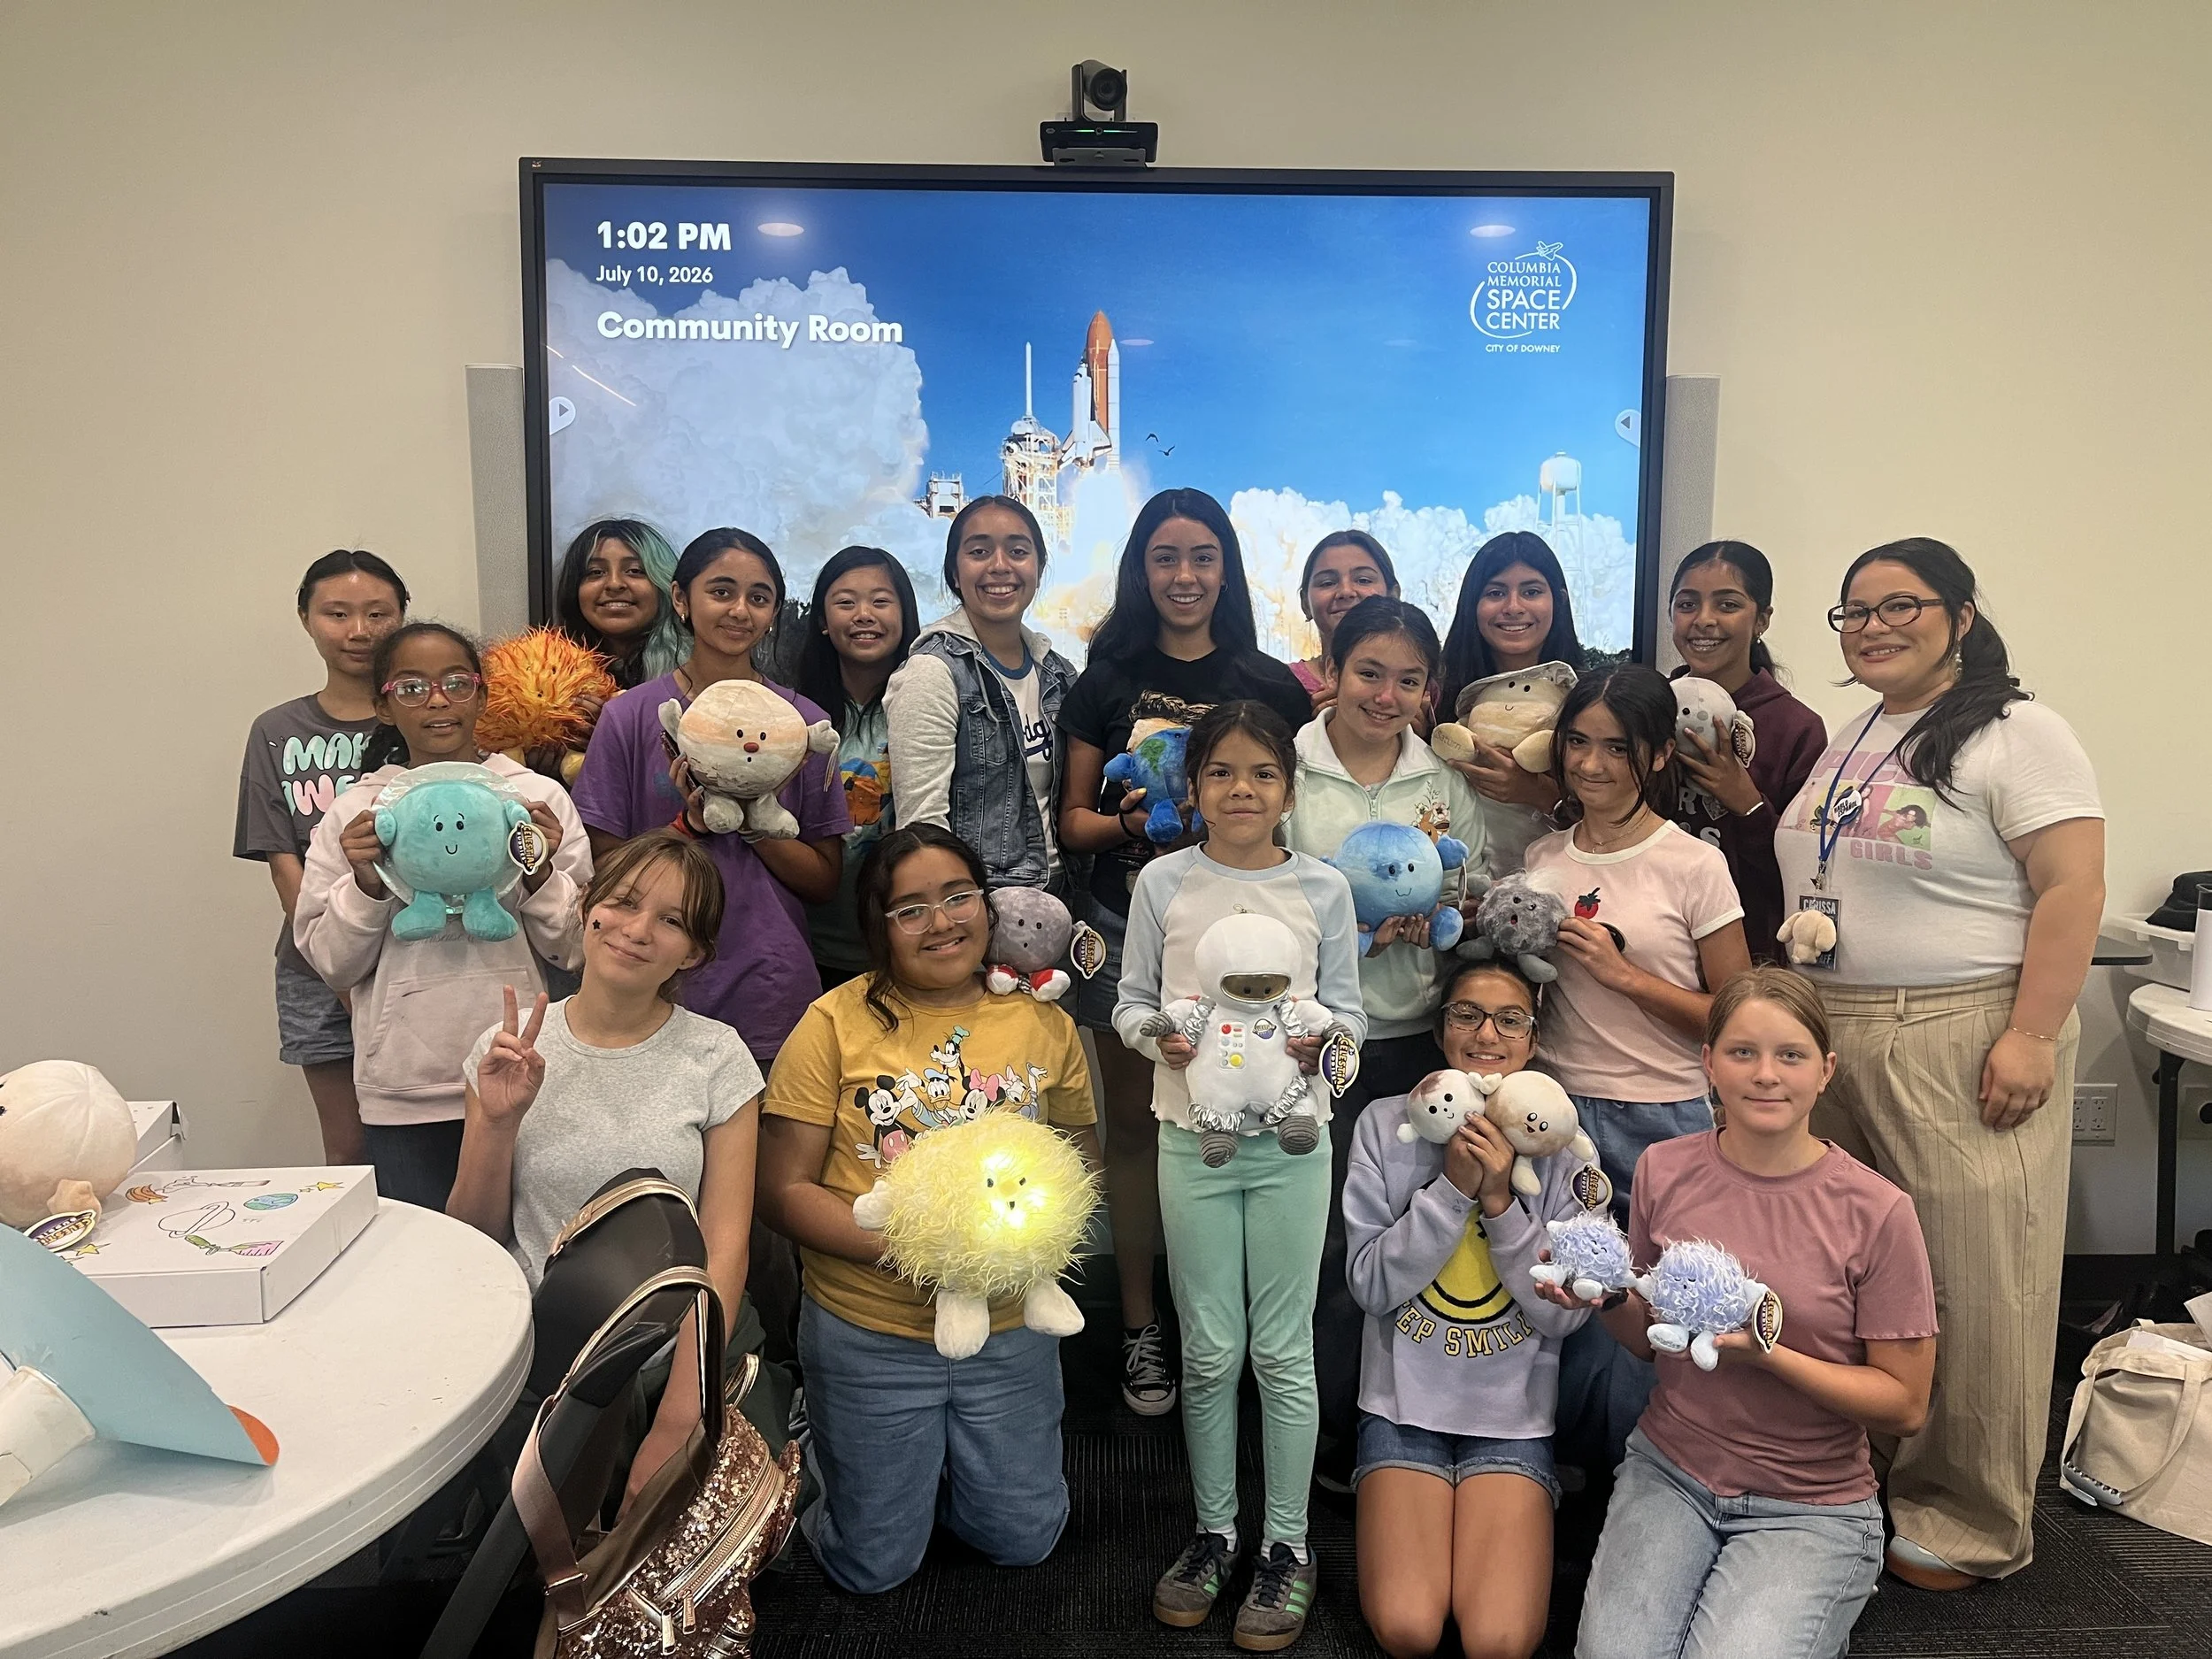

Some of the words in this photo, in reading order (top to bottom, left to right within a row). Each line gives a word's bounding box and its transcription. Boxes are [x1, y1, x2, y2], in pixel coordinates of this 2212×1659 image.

[596, 220, 667, 250] 1:02
[678, 222, 732, 250] PM
[595, 265, 632, 287] July
[637, 266, 664, 286] 10,
[669, 267, 713, 284] 2026
[1487, 261, 1561, 273] COLUMBIA
[1487, 275, 1562, 287] MEMORIAL
[1486, 288, 1561, 310] SPACE
[596, 311, 799, 349] Community
[809, 315, 902, 342] Room
[1486, 311, 1560, 329] CENTER
[1521, 344, 1560, 353] DOWNEY
[282, 732, 368, 775] MAK
[523, 826, 535, 868] CELESTIAL
[1850, 839, 1933, 871] GIRLS
[1087, 932, 1096, 972] CELESTIAL
[1336, 1038, 1348, 1090] CELESTIAL
[1587, 1170, 1599, 1208] CELESTIAL
[1395, 1300, 1436, 1343] EP
[1444, 1310, 1532, 1358] SMILI
